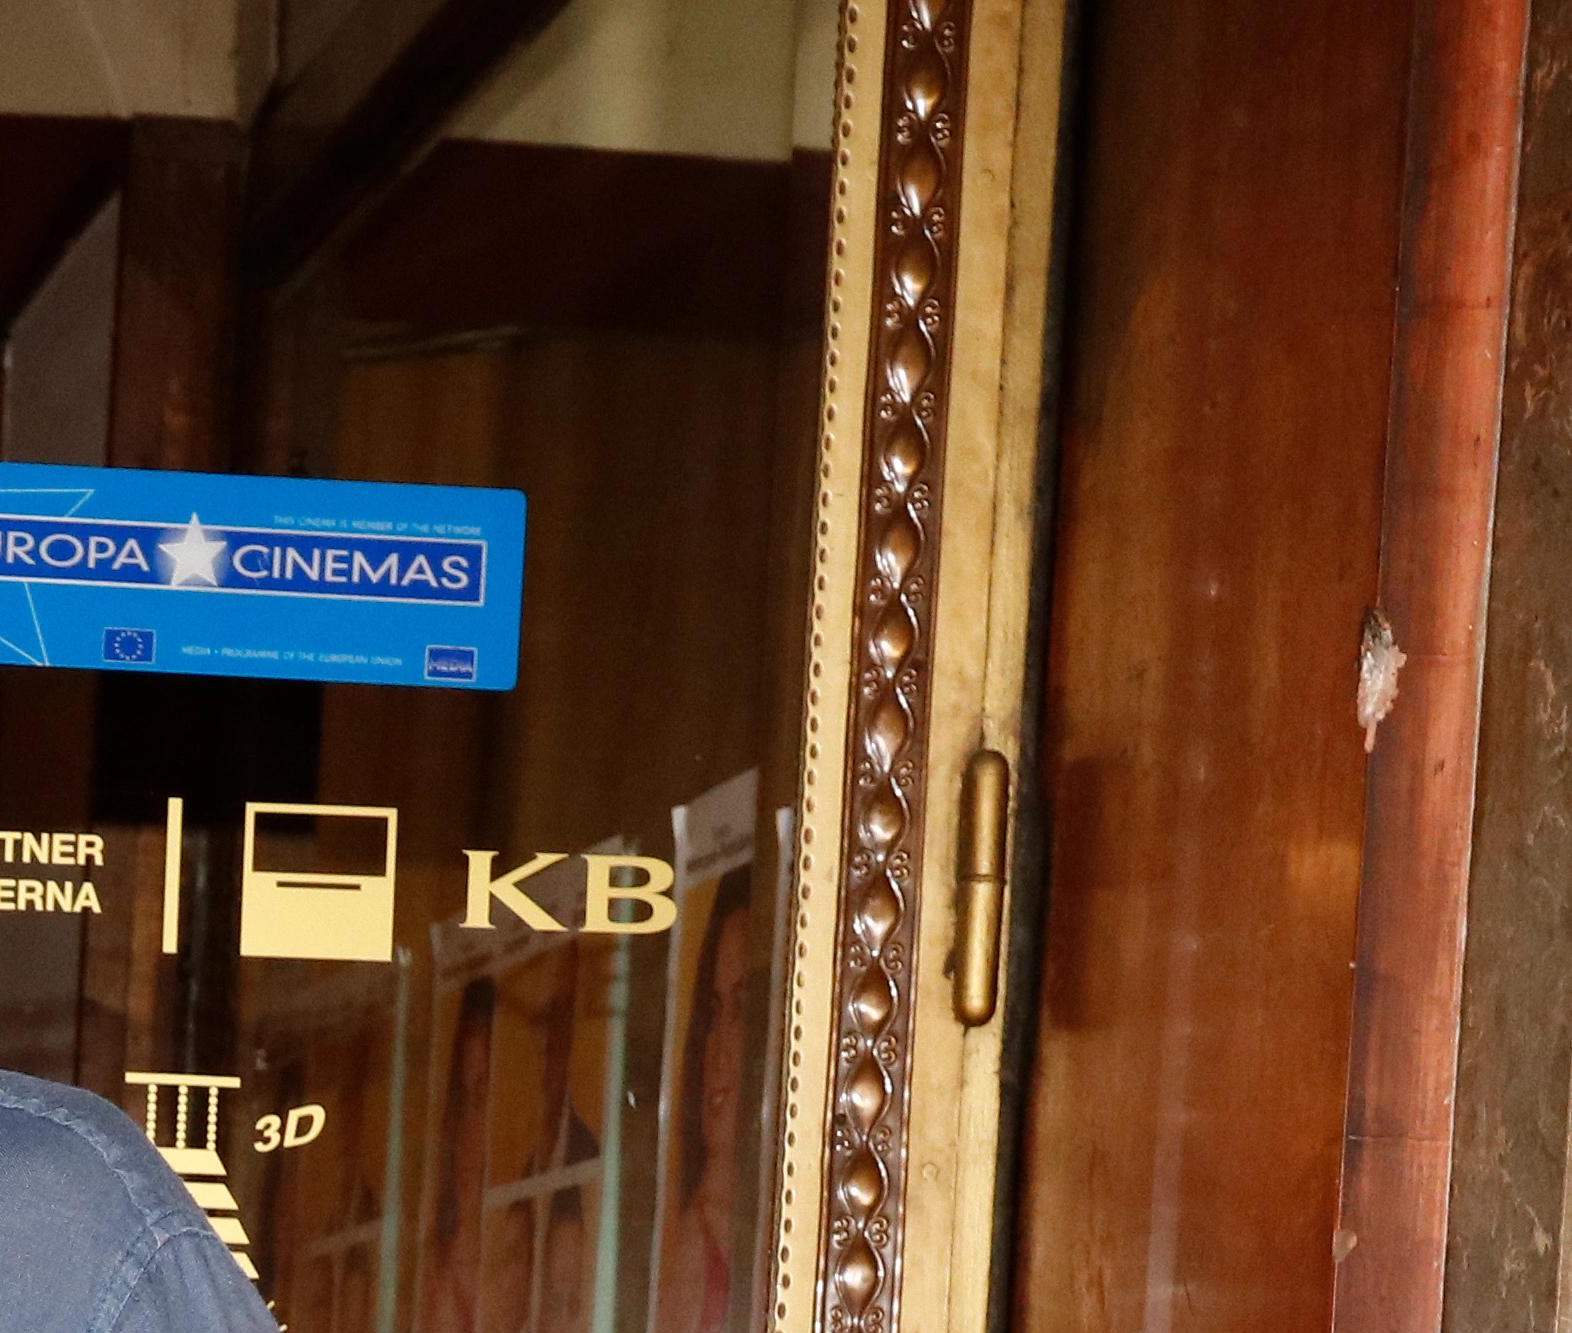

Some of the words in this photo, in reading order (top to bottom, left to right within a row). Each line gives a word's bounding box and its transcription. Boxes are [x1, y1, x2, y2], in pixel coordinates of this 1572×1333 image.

[232, 543, 470, 591] CINEMAS
[459, 849, 678, 934] KB
[253, 1104, 326, 1153] 3D
